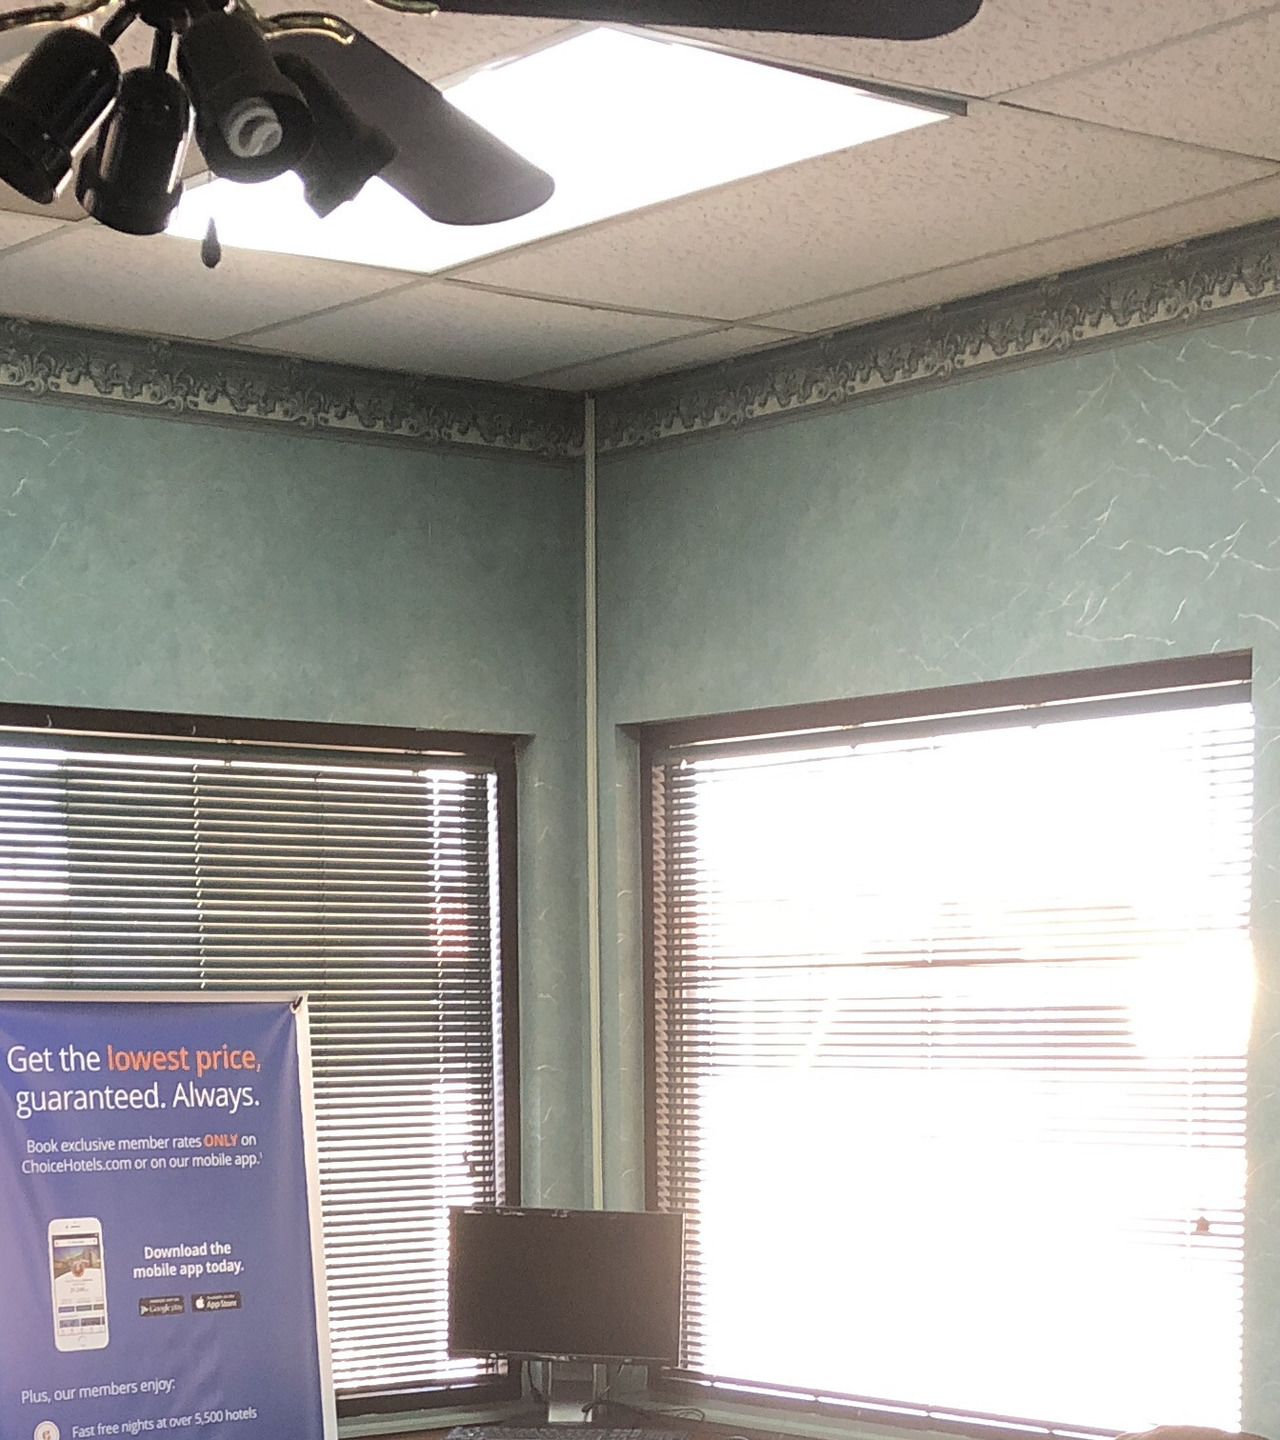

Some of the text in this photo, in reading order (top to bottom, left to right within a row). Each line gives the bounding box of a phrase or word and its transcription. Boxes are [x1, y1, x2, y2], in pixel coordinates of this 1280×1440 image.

[7, 1043, 261, 1078] Get the lowest price,
[16, 1080, 260, 1119] guaranteed. Always.
[26, 1134, 257, 1153] Book exclusive member rates ONLY on
[22, 1158, 132, 1174] ChoiceHotels.com
[134, 1158, 148, 1169] or
[150, 1157, 167, 1168] on
[169, 1156, 189, 1168] our
[192, 1152, 232, 1167] mobile
[144, 1241, 232, 1260] Download the
[133, 1259, 245, 1278] mobile app today.
[21, 1377, 176, 1404] Plus, our members enjoy:
[72, 1406, 258, 1438] Fast free nights at over 5,500 hotels
